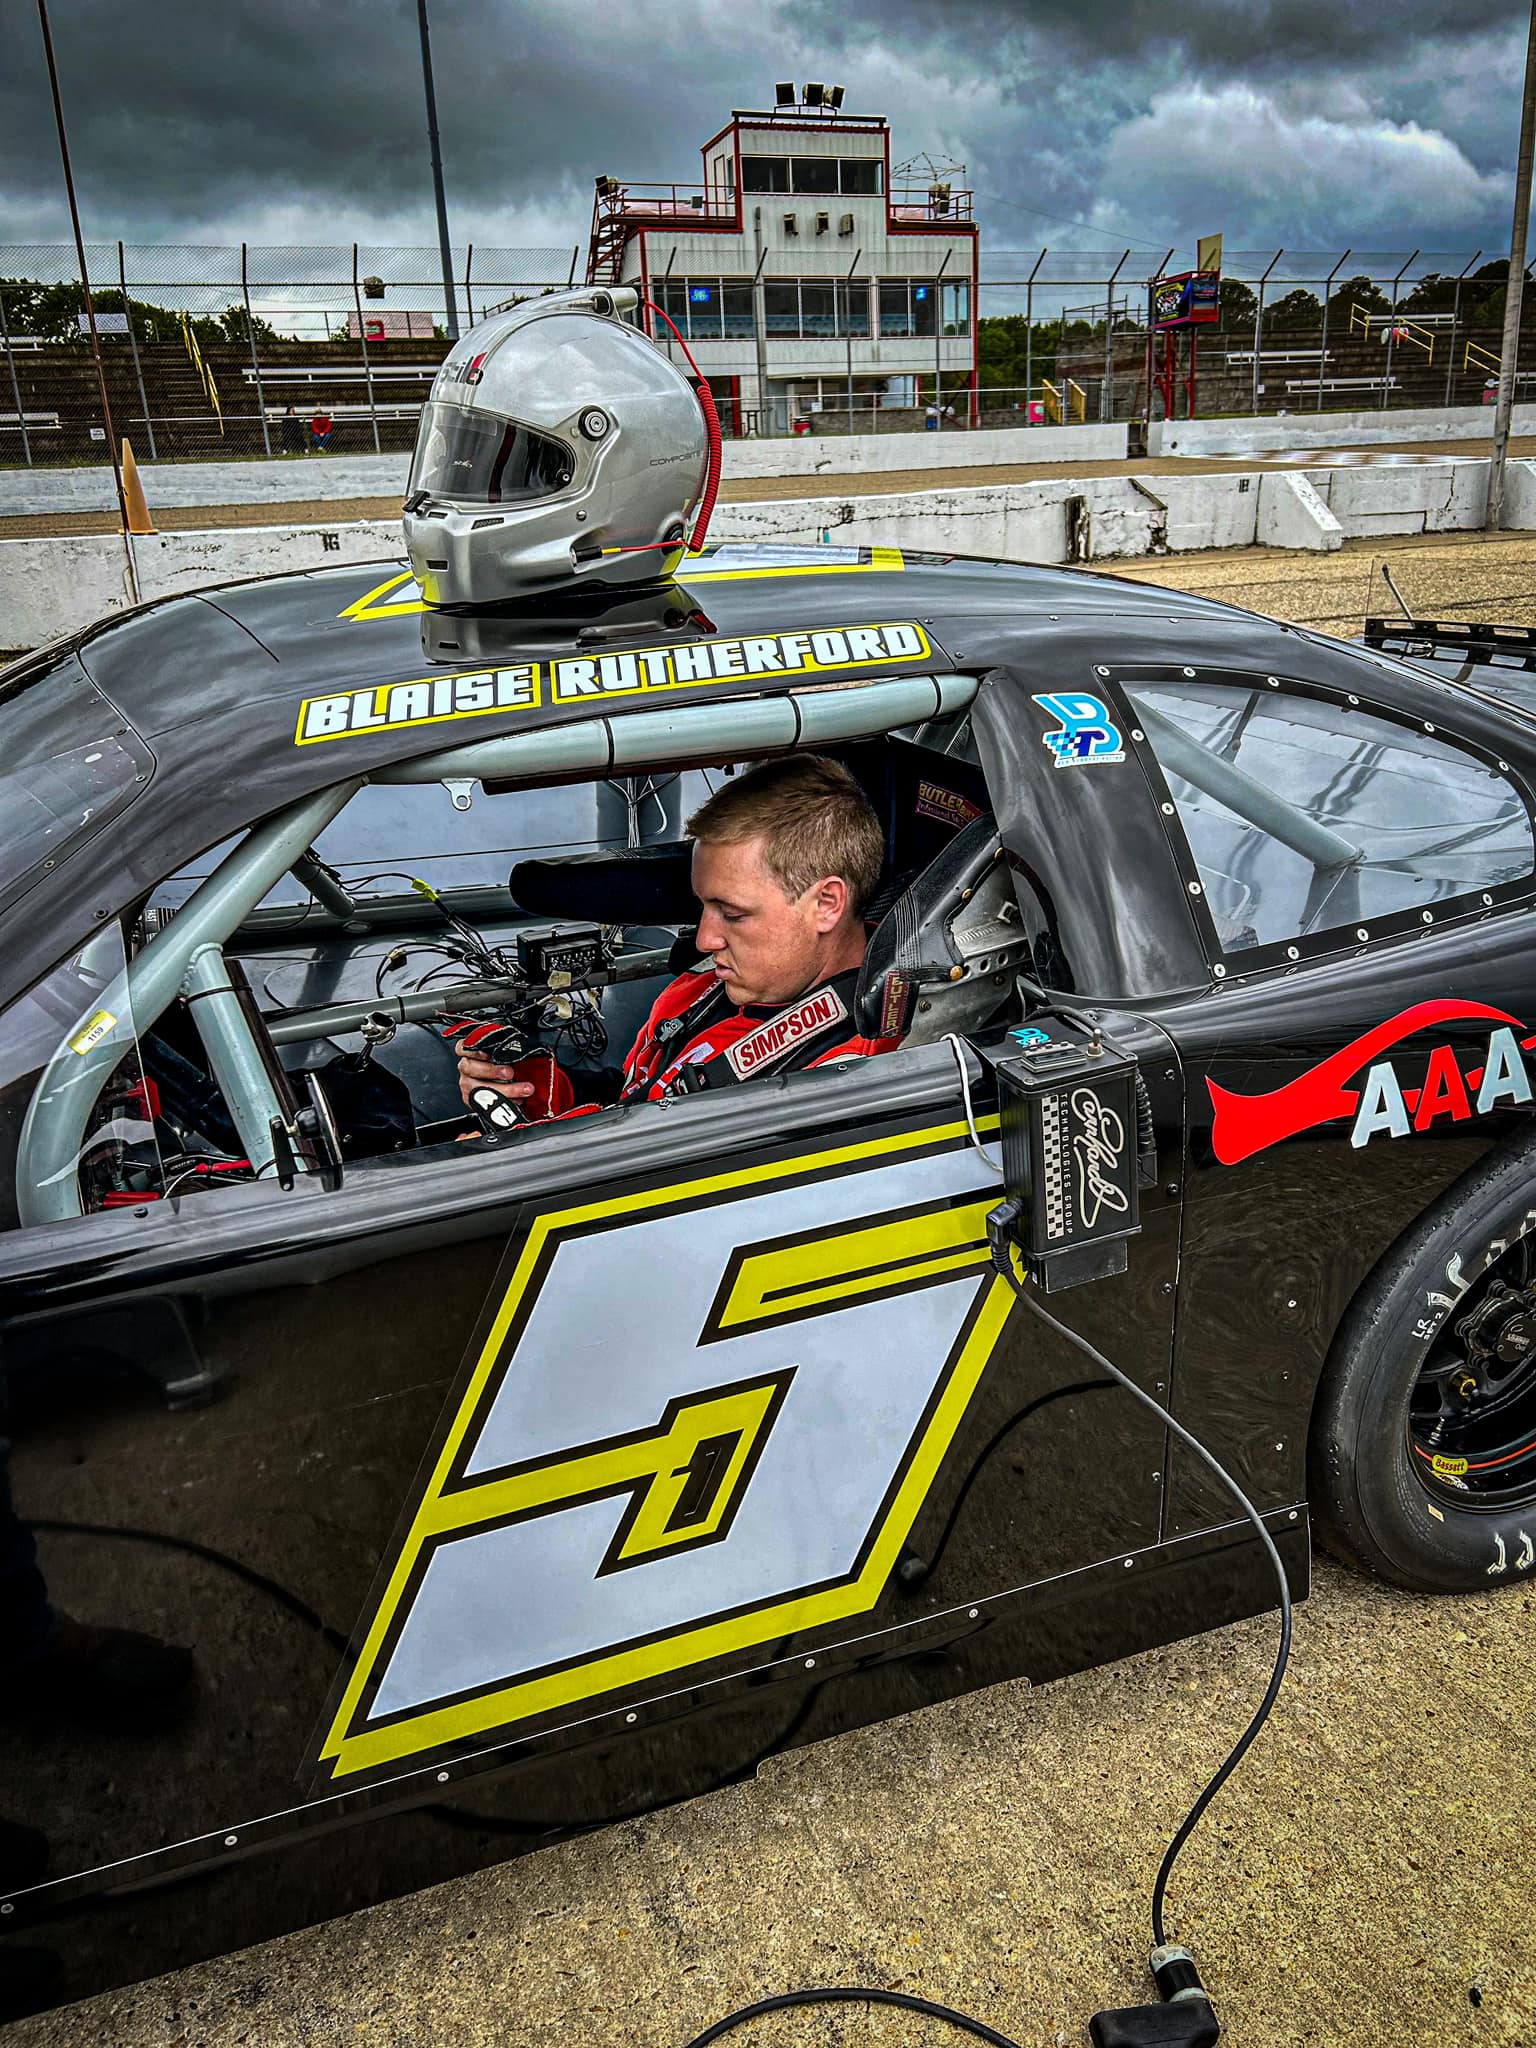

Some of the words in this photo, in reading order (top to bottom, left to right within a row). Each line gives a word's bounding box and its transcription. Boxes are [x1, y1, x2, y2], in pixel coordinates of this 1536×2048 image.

[303, 666, 534, 738] BLAISE
[557, 624, 922, 698] RUTHERFORD
[918, 783, 964, 809] BUTLER
[740, 996, 832, 1067] SIMPSON
[1059, 1092, 1072, 1189] TECHNOLOGIES
[1065, 1193, 1074, 1235] GROUP
[1411, 1318, 1432, 1339] LR
[345, 1125, 1022, 1750] 5
[1435, 1458, 1465, 1472] Bassett
